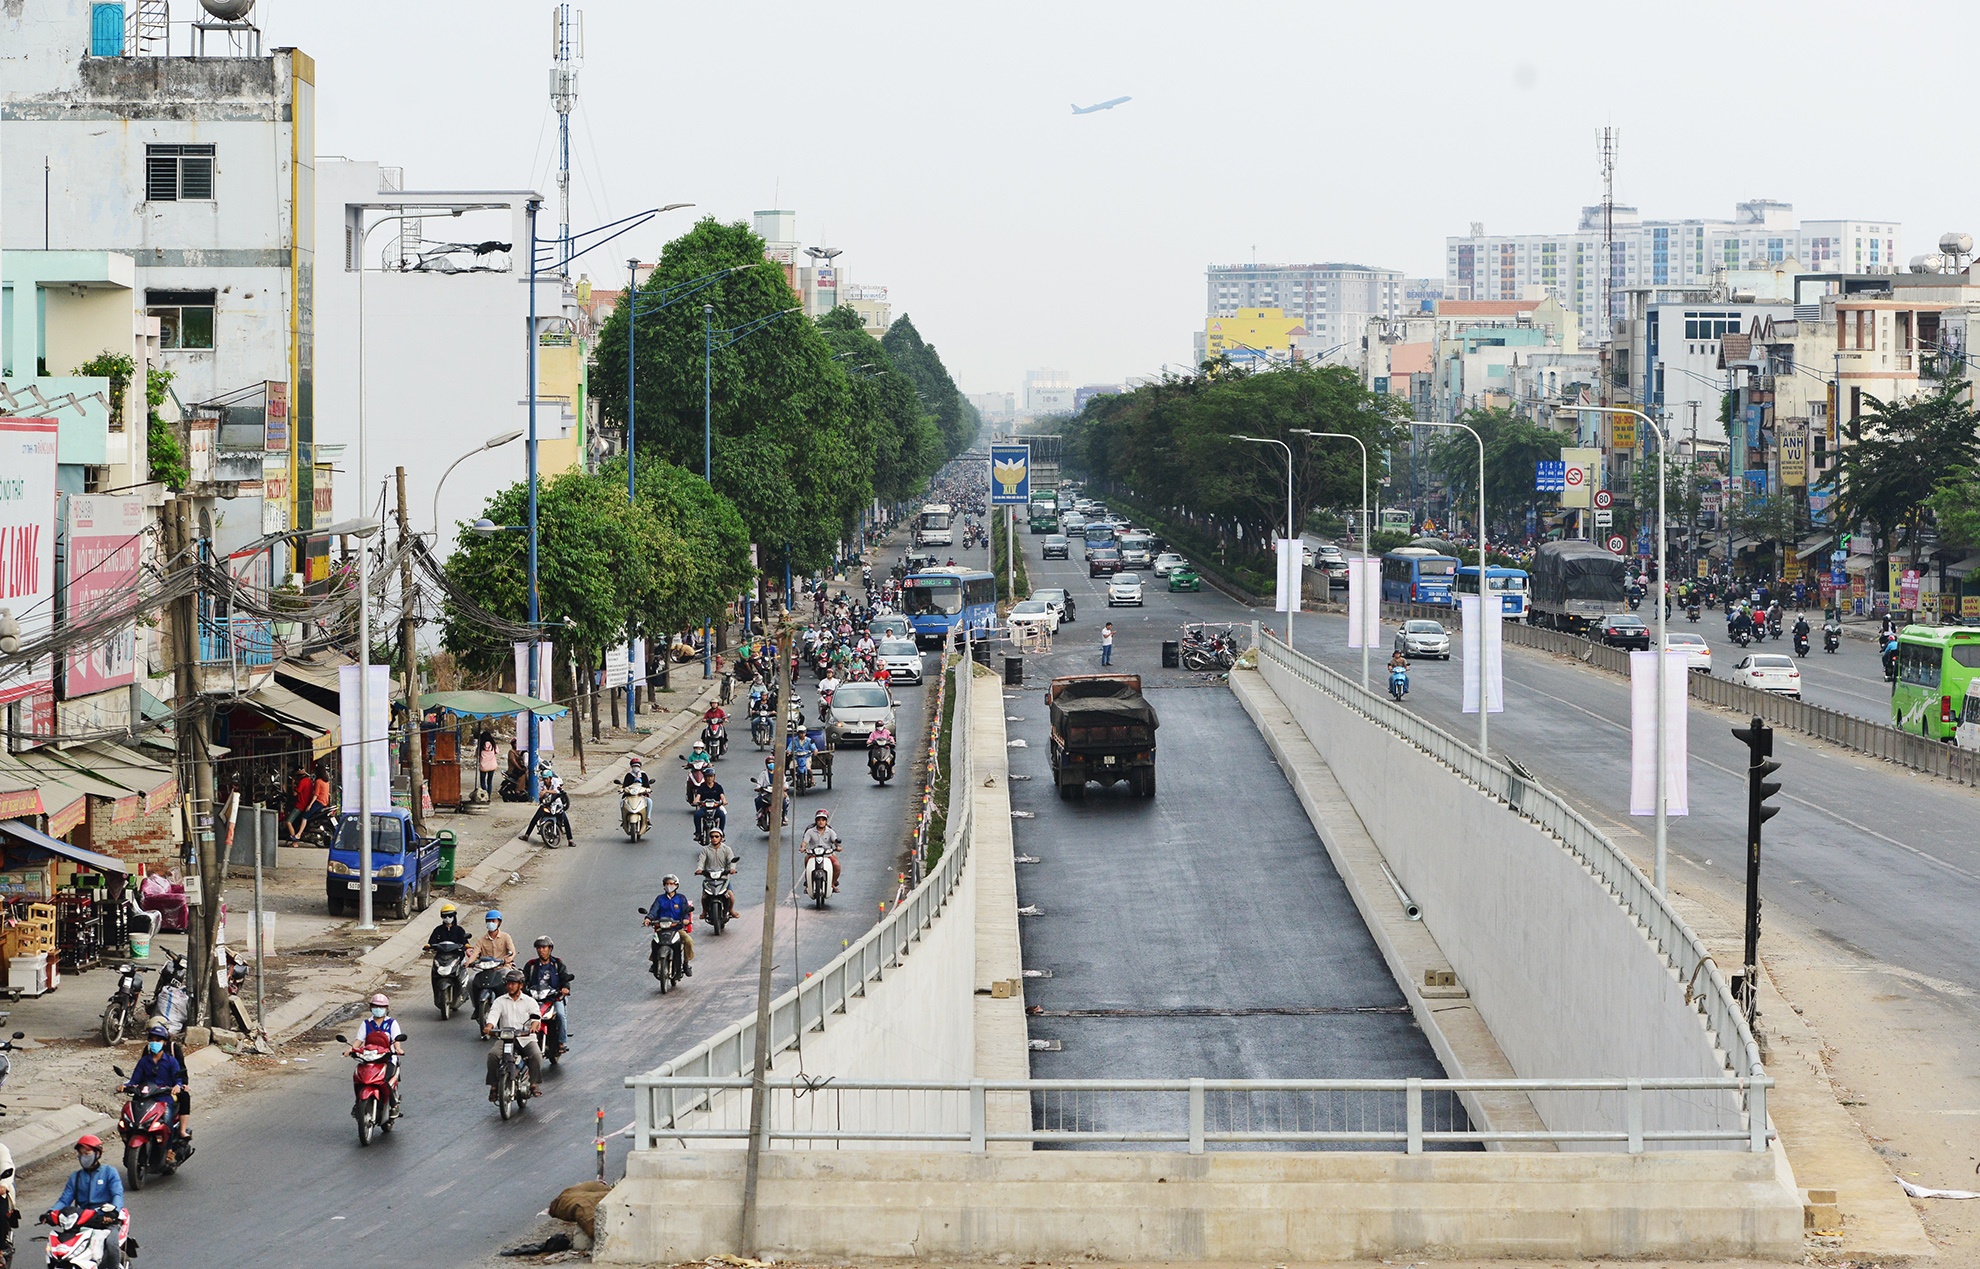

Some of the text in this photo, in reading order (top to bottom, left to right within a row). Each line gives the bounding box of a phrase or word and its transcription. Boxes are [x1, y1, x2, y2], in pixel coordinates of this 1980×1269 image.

[1783, 437, 1804, 448] ANH
[1598, 494, 1609, 504] 80
[1611, 539, 1622, 549] 60
[9, 523, 39, 598] LONG
[120, 546, 135, 572] LONG
